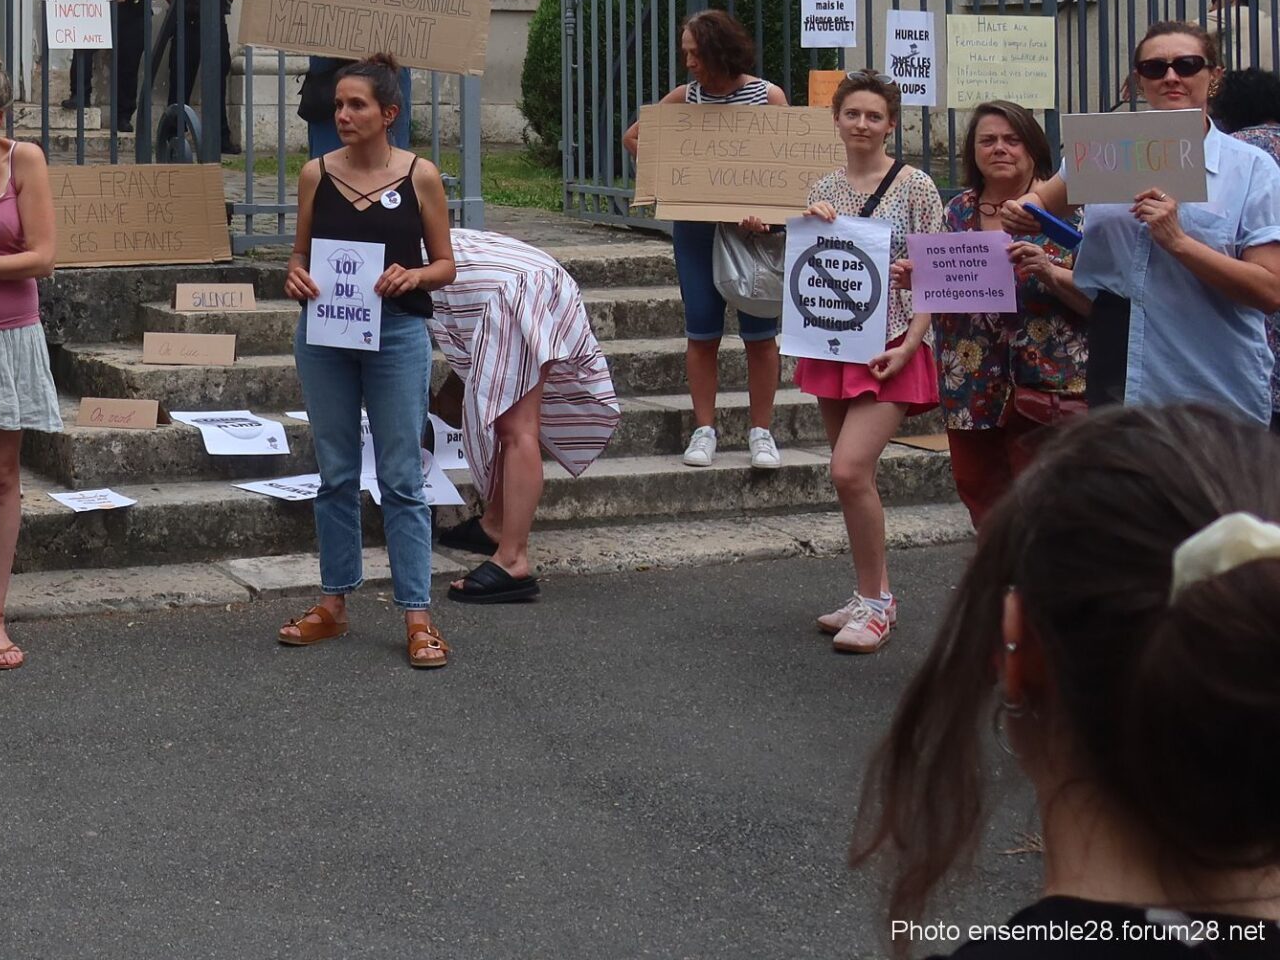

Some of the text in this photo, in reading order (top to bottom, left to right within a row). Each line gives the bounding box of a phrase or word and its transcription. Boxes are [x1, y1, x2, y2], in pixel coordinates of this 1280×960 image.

[816, 0, 844, 10] mais le
[978, 17, 1008, 32] HALTE
[83, 34, 104, 43] ANTE
[895, 29, 929, 41] HURLER
[893, 65, 930, 78] CONTRE
[676, 112, 693, 132] 3
[702, 111, 812, 136] ENFANTS
[680, 140, 750, 157] CLASSE
[99, 170, 182, 198] FRANCE
[672, 167, 788, 189] DE VIOLENCES
[64, 202, 173, 224] N'AIME PAS
[70, 231, 184, 253] SES ENFANTS
[816, 236, 854, 250] Prière
[926, 244, 989, 255] nos enfants
[335, 261, 357, 275] LOI
[808, 256, 864, 271] de ne pas
[932, 258, 987, 268] sont notre
[808, 275, 863, 292] déranger
[945, 272, 979, 282] avenir
[335, 283, 354, 298] DU
[924, 287, 1005, 300] protégeons-les
[800, 294, 870, 312] les hommes
[317, 304, 371, 322] SILENCE
[803, 316, 863, 332] politiques
